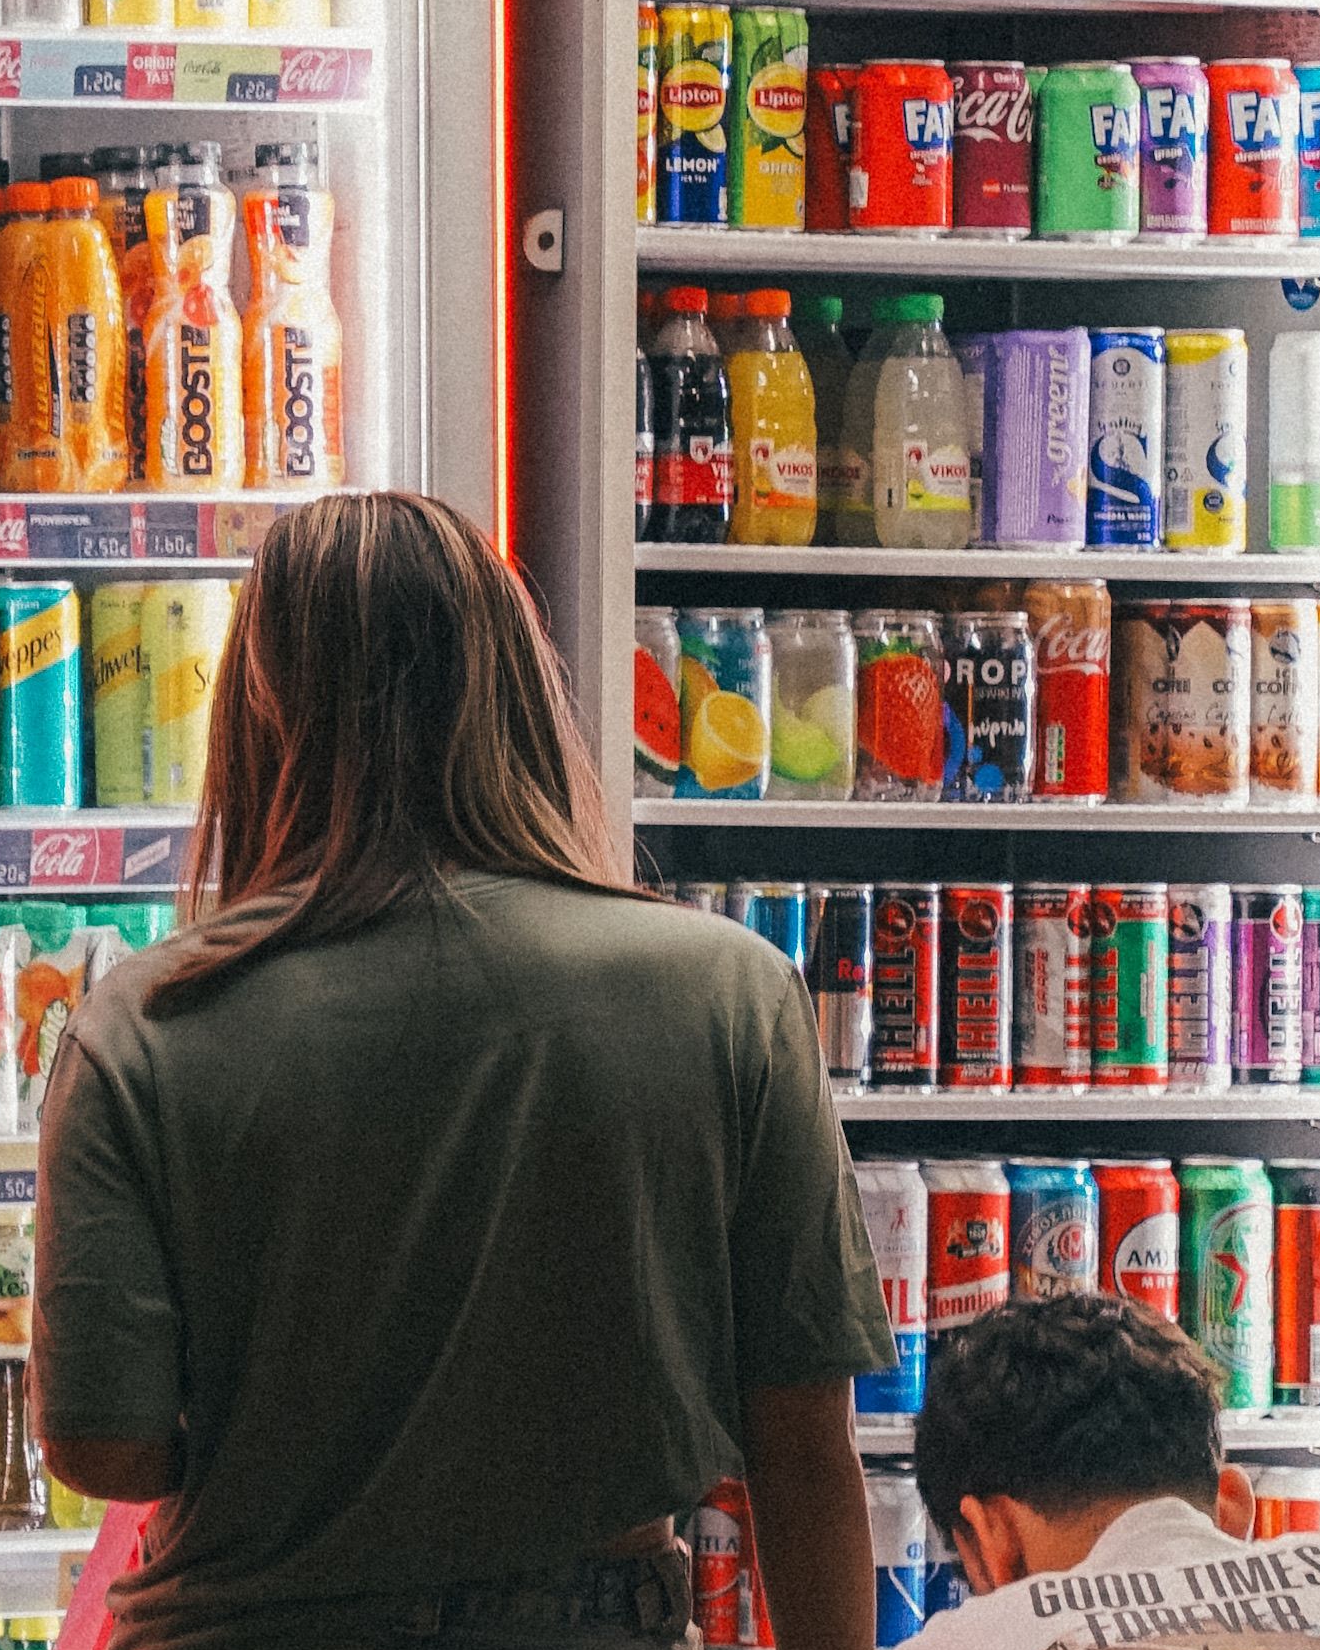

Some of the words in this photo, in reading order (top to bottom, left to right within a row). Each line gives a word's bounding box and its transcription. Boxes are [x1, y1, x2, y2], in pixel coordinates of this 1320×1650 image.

[80, 69, 123, 93] 1.20€
[233, 79, 275, 101] 1.20€
[667, 83, 719, 109] Lipton
[759, 86, 804, 111] Lipton
[665, 156, 719, 174] LEMON
[180, 344, 214, 476] BOOST
[284, 344, 316, 477] BOOST
[776, 463, 813, 478] VIKOS
[930, 463, 968, 479] VIKOS
[31, 833, 92, 878] Cola
[956, 946, 1000, 1052] HELL
[1028, 1569, 1165, 1621] GOOD
[1083, 1593, 1314, 1650] FOREVER
